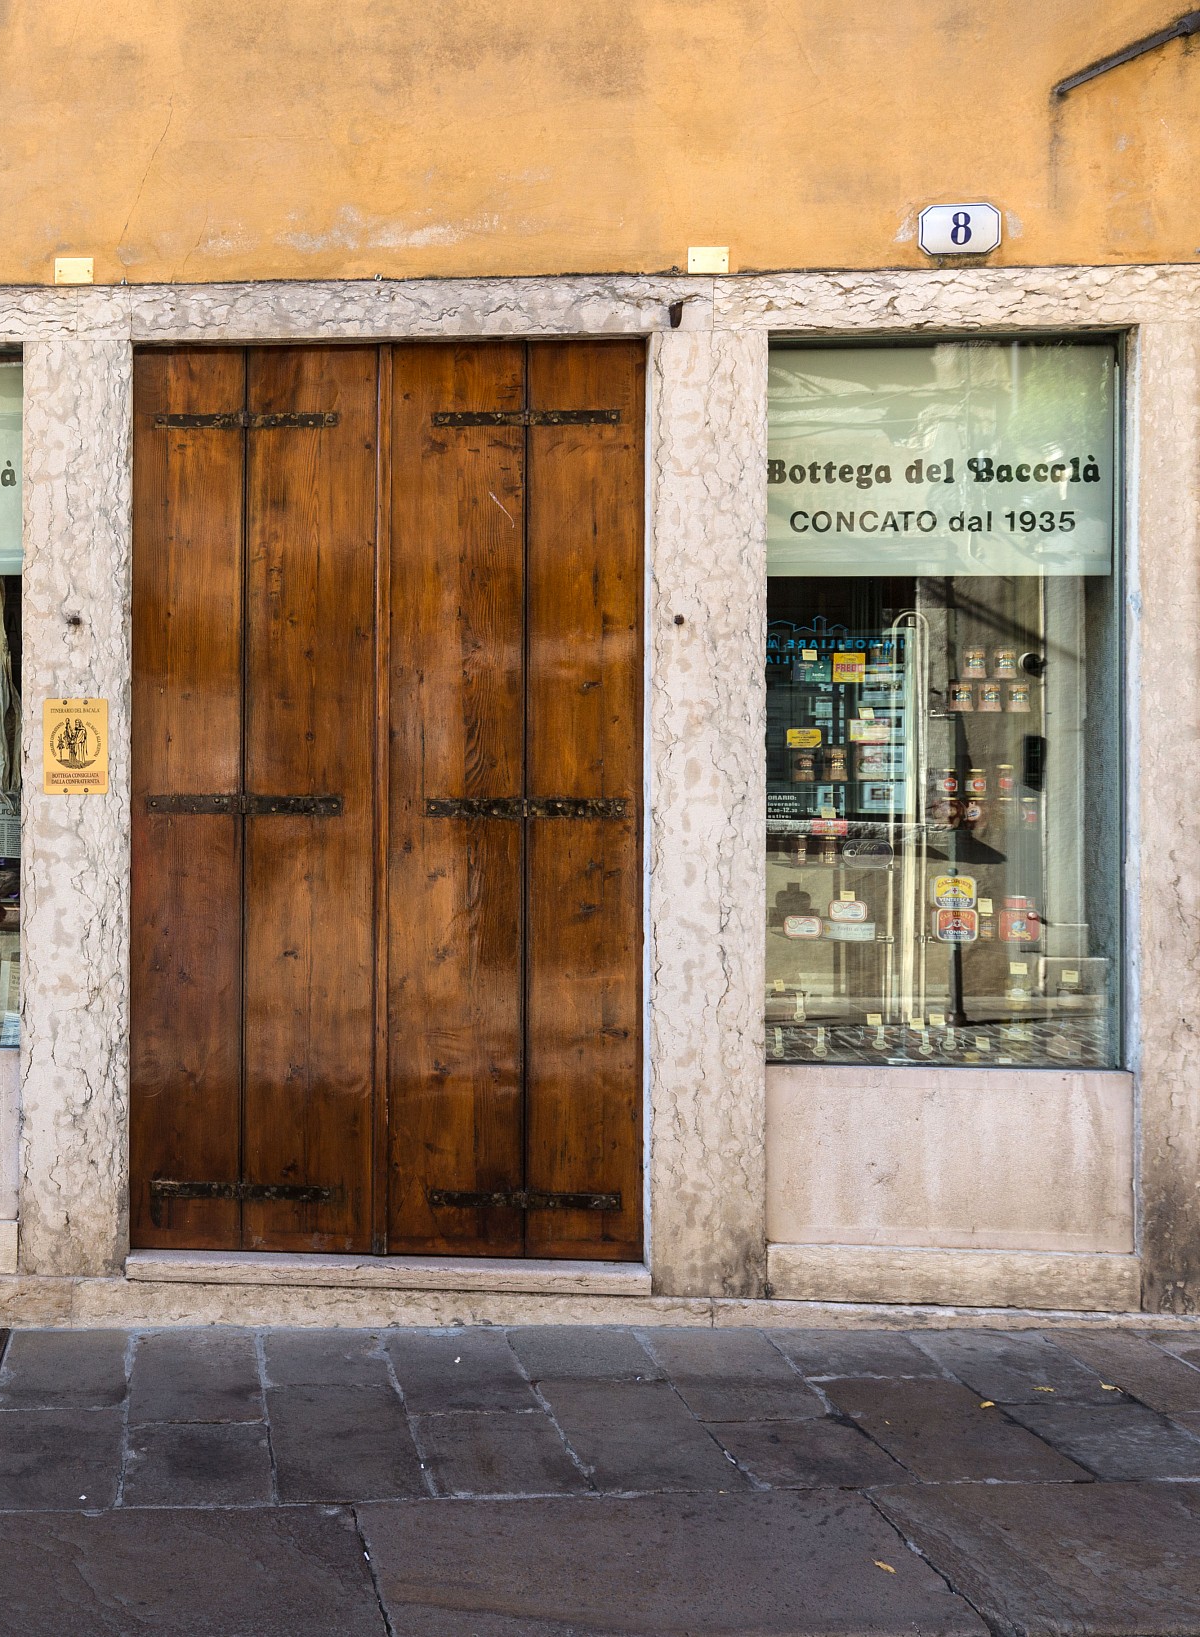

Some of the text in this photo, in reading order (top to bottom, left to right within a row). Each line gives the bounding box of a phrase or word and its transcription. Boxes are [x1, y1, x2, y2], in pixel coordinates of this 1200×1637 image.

[950, 211, 972, 245] 8
[767, 455, 1101, 490] Bottega del Baccalà
[789, 510, 1076, 533] CONCATO dal 1935
